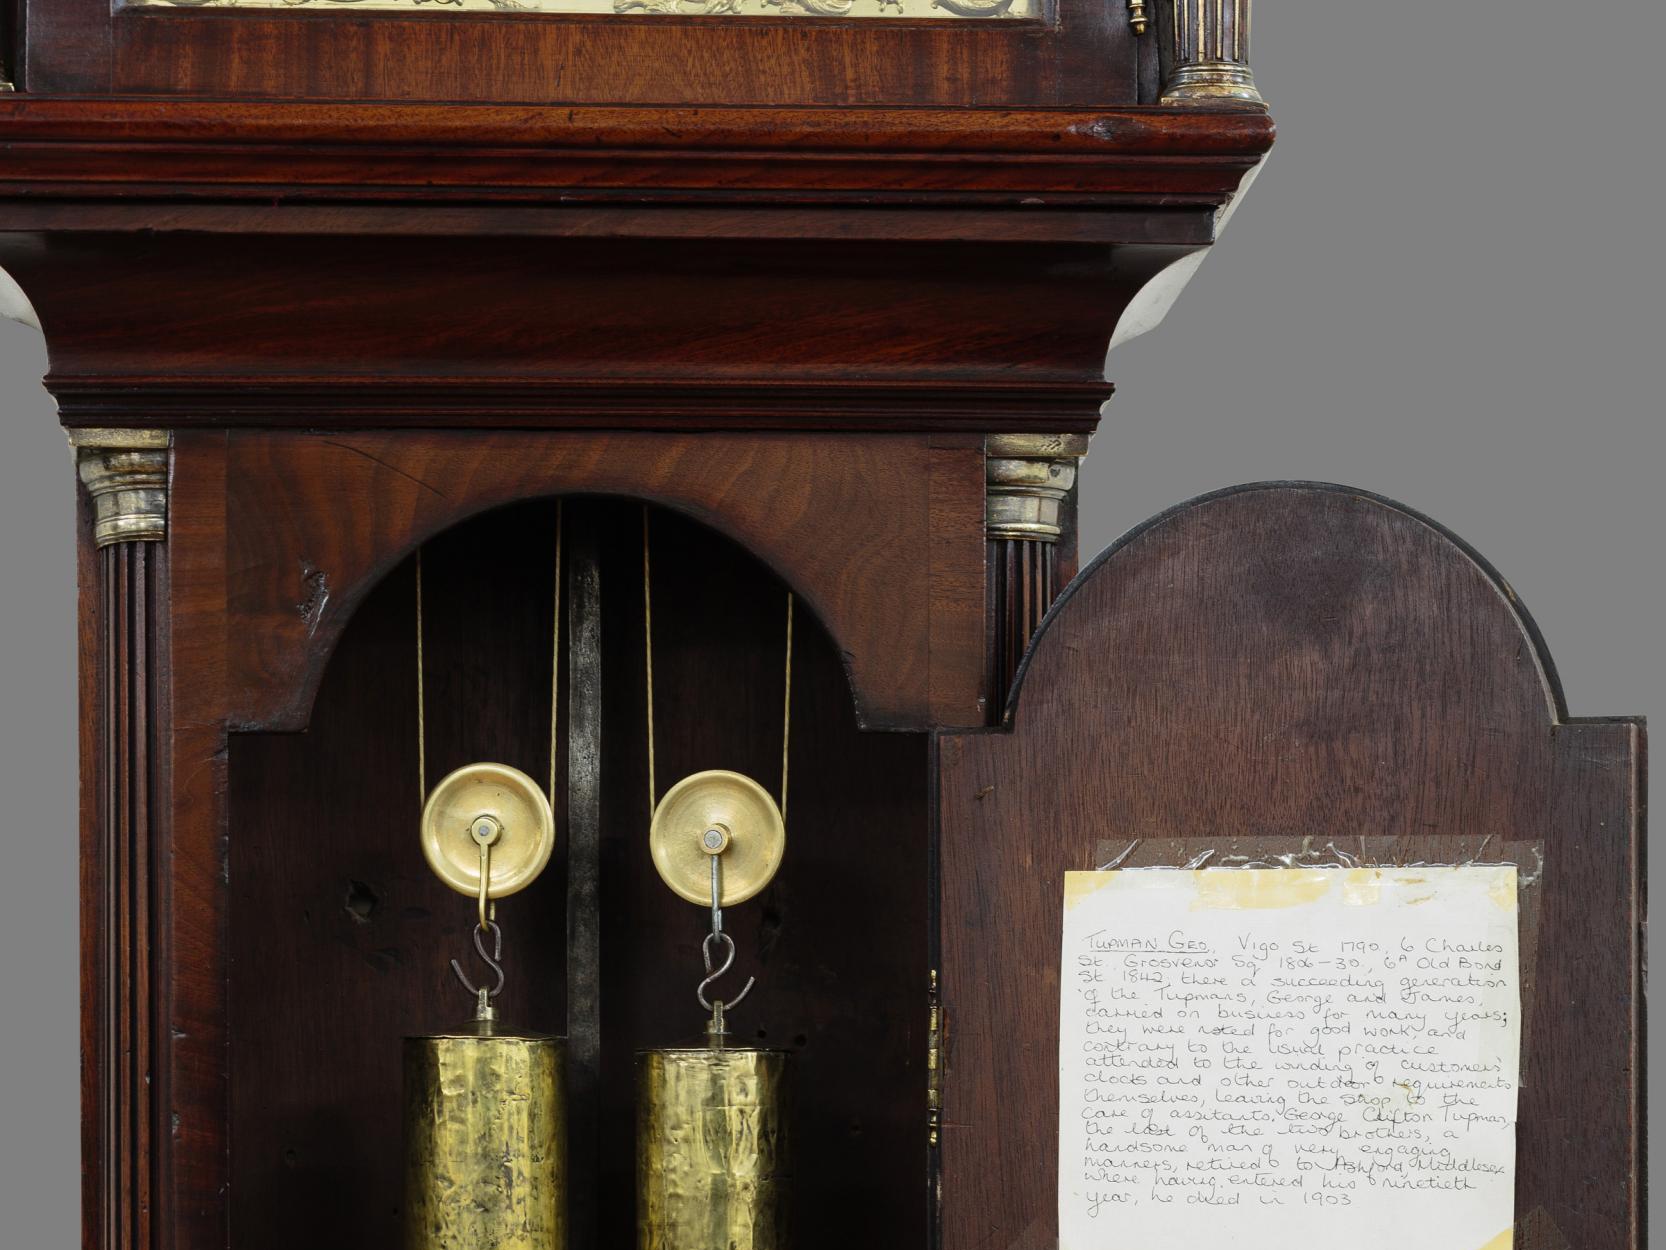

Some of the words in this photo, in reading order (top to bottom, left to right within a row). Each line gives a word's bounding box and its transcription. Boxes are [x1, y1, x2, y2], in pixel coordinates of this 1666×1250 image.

[1238, 932, 1280, 960] Vigo
[1292, 941, 1320, 953] St
[1401, 937, 1414, 952] 6
[1425, 937, 1503, 952] Charles
[1123, 954, 1219, 968] Grosvenor
[1232, 955, 1261, 977] Sq
[1417, 957, 1449, 969] Old
[1459, 957, 1502, 970] Bond
[1182, 972, 1228, 986] there
[1241, 978, 1256, 986] a
[1271, 975, 1384, 997] succeeding
[1400, 974, 1507, 997] generation
[1084, 988, 1100, 1012] of
[1111, 987, 1140, 1000] the
[1153, 985, 1255, 1008] Tupmans,
[1267, 990, 1332, 1013] George
[1347, 993, 1386, 1003] and
[1401, 990, 1483, 1006] James,
[1086, 1007, 1163, 1018] carried
[1177, 1009, 1199, 1018] on
[1218, 1004, 1305, 1019] business
[1324, 1009, 1350, 1029] for
[1366, 1010, 1425, 1032] many
[1086, 1021, 1127, 1043] they
[1142, 1024, 1185, 1034] were
[1198, 1024, 1254, 1035] noted
[1268, 1023, 1296, 1047] for
[1304, 1022, 1350, 1048] good
[1364, 1025, 1417, 1040] work,
[1428, 1028, 1465, 1040] and
[1084, 1040, 1174, 1062] contrary
[1188, 1040, 1207, 1052] to
[1222, 1042, 1252, 1054] the
[1269, 1044, 1324, 1054] usual
[1339, 1044, 1439, 1062] practice
[1086, 1054, 1178, 1069] attended
[1194, 1055, 1211, 1068] to
[1224, 1056, 1263, 1070] the
[1365, 1060, 1383, 1084] of
[1084, 1071, 1147, 1085] clocks
[1157, 1075, 1201, 1086] and
[1220, 1074, 1274, 1088] other
[1393, 1077, 1512, 1097] requirements
[1084, 1088, 1205, 1107] themselves,
[1216, 1089, 1286, 1114] leaving
[1298, 1092, 1329, 1105] the
[1340, 1094, 1391, 1109] shop
[1407, 1090, 1425, 1105] to
[1443, 1094, 1480, 1106] the
[1086, 1121, 1113, 1135] the
[1124, 1123, 1175, 1136] last
[1189, 1126, 1208, 1143] of
[1222, 1124, 1264, 1136] the
[1277, 1125, 1328, 1136] two
[1339, 1126, 1430, 1143] brothers,
[1443, 1130, 1459, 1139] a
[1141, 1109, 1153, 1128] of
[1284, 1107, 1347, 1131] George
[1363, 1107, 1433, 1132] Clifton
[1085, 1156, 1177, 1173] manners,
[1187, 1157, 1261, 1170] retired
[1297, 1159, 1313, 1170] to
[1086, 1137, 1189, 1152] handsome
[1208, 1143, 1252, 1152] man
[1262, 1144, 1279, 1167] of
[1295, 1144, 1339, 1157] very
[1361, 1145, 1450, 1165] engaging
[1085, 1168, 1140, 1183] where
[1155, 1169, 1216, 1199] having
[1228, 1173, 1303, 1186] entered
[1323, 1174, 1356, 1189] his
[1383, 1176, 1477, 1190] ninetieth
[1087, 1192, 1137, 1217] year,
[1152, 1187, 1173, 1203] he
[1187, 1193, 1240, 1205] died
[1260, 1190, 1285, 1205] in
[1304, 1192, 1352, 1206] 1903
